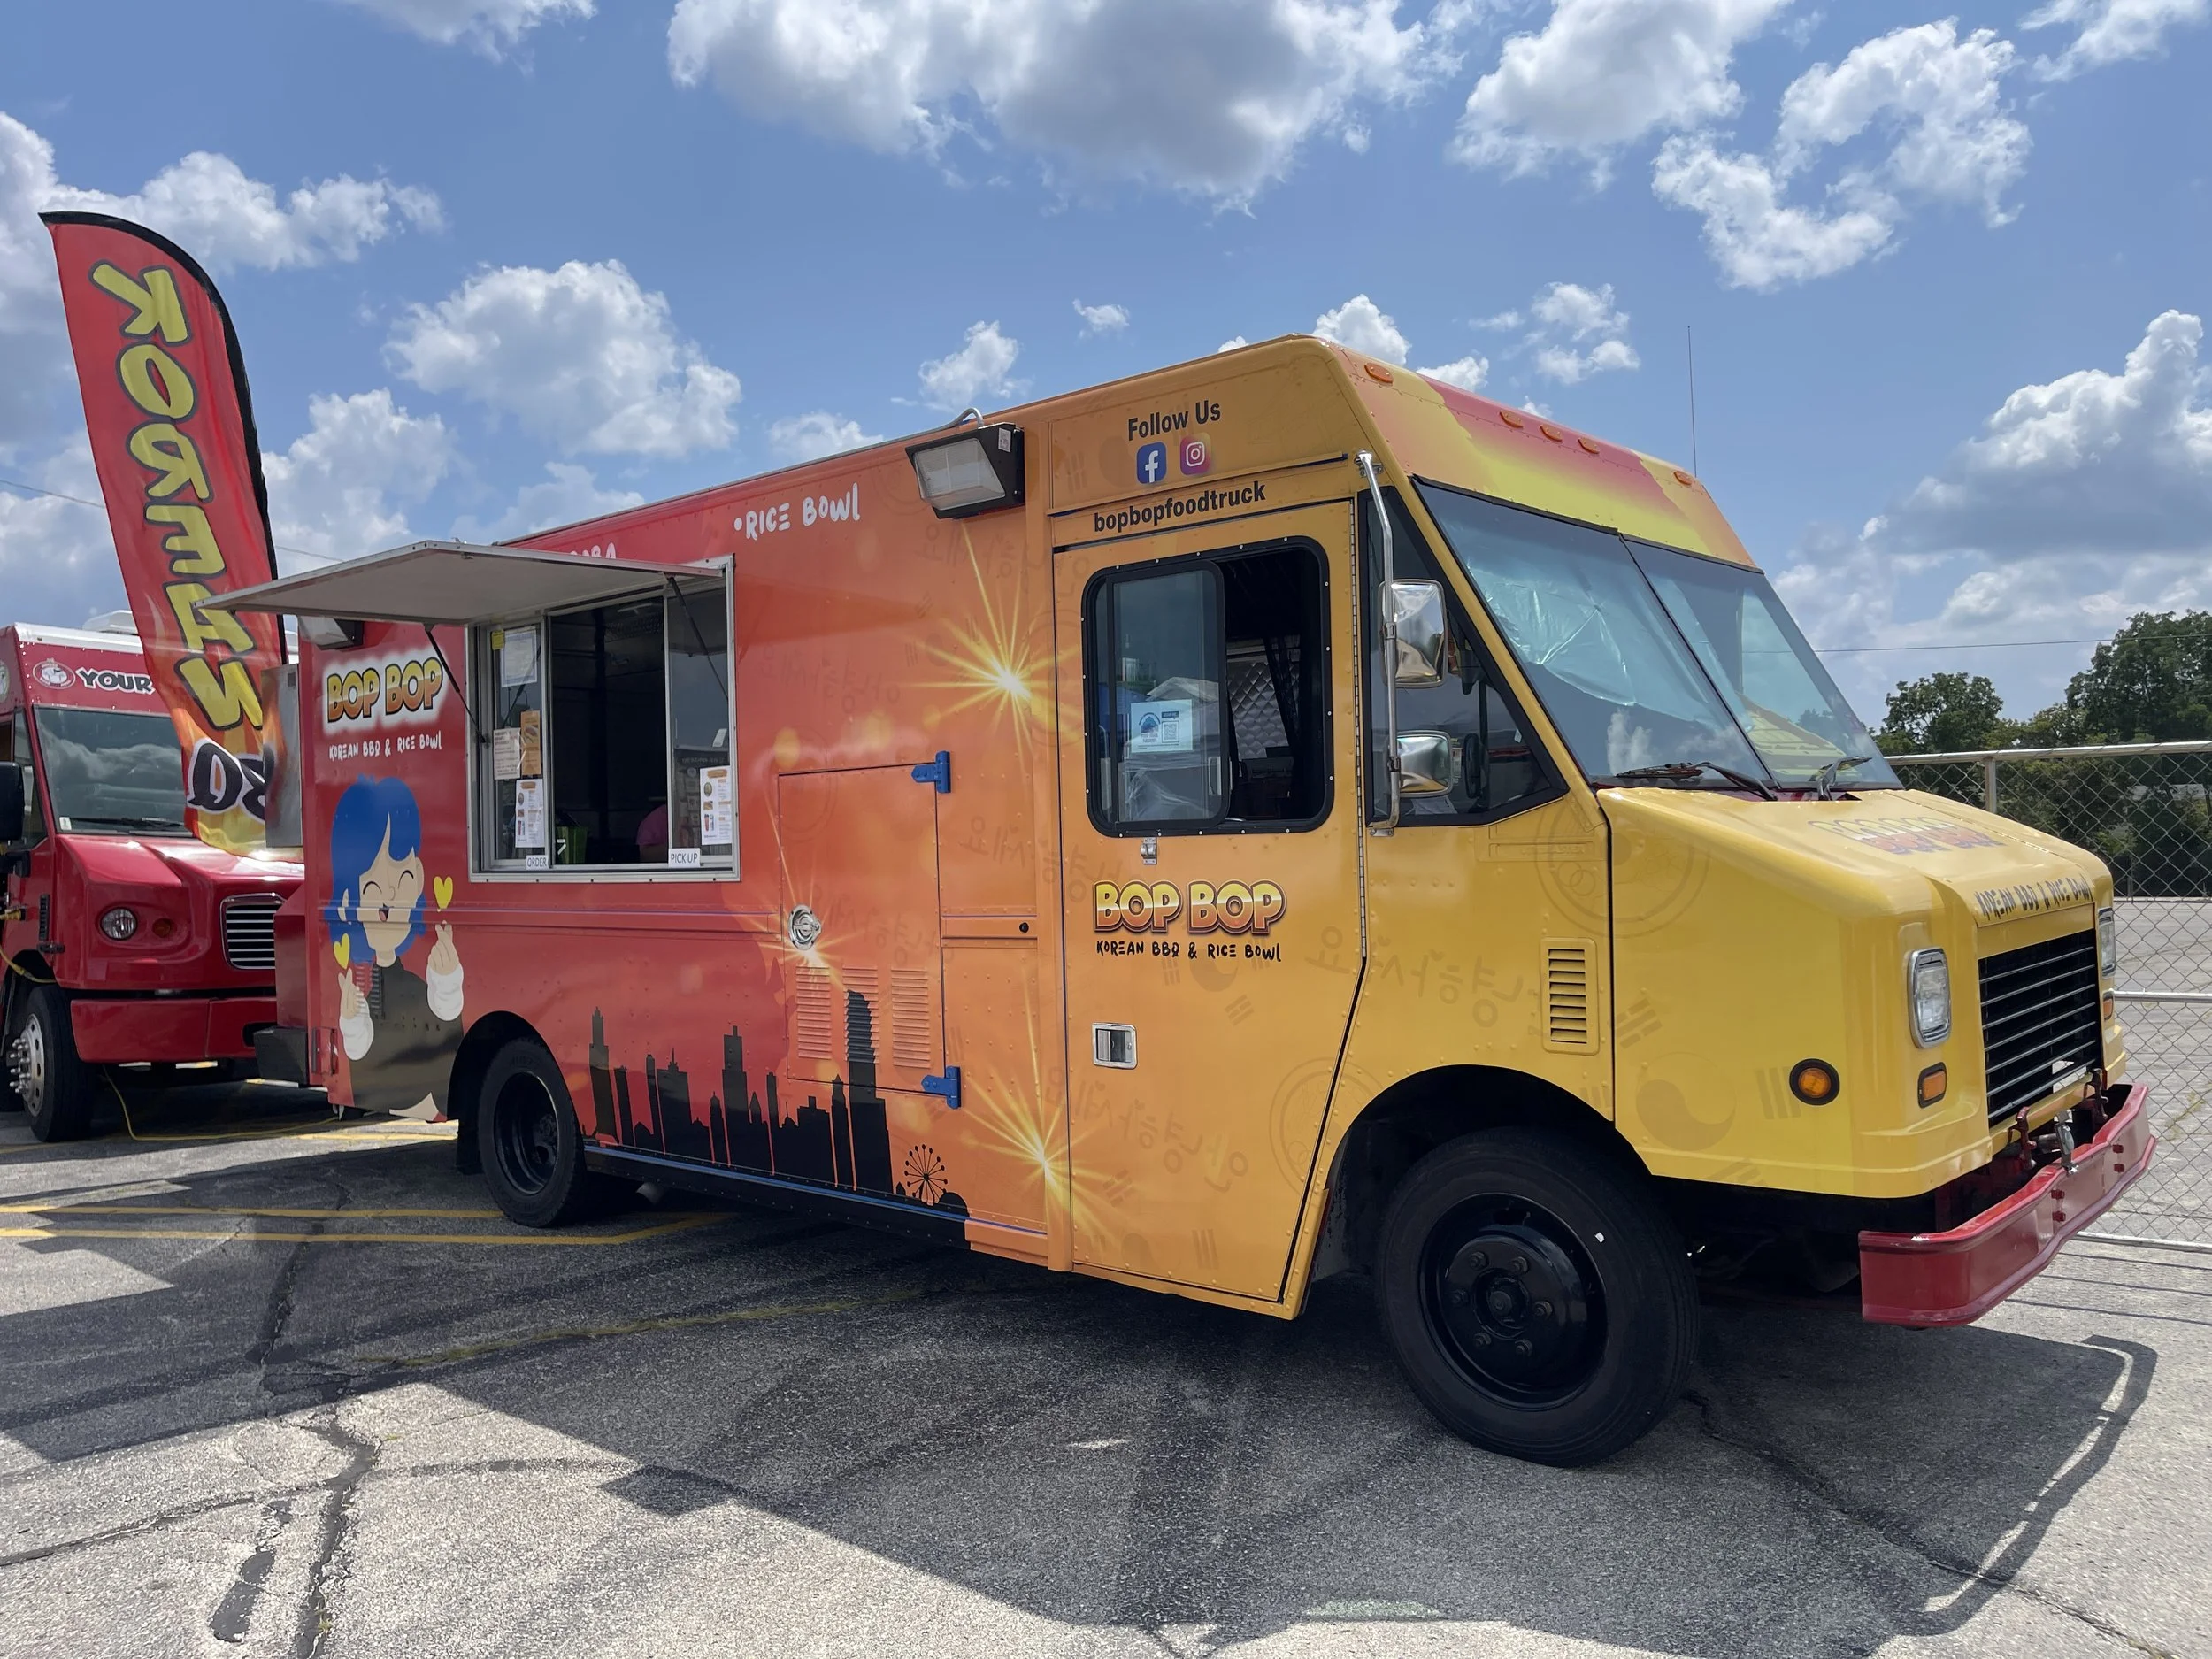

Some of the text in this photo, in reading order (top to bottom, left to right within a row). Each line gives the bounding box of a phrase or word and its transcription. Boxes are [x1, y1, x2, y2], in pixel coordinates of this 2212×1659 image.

[1128, 400, 1221, 442] Follow Us
[744, 502, 791, 541] RICE
[1094, 480, 1266, 533] bopbopfoodtruck
[77, 669, 153, 694] YOUR
[327, 667, 380, 723] BOP
[384, 657, 444, 716] BOP
[329, 730, 442, 762] KOREAN BBQ & RICE BOWL
[526, 856, 547, 868] ORDER
[671, 851, 699, 864] PICK UP
[1094, 879, 1286, 935] BOP BOP
[1974, 888, 2016, 920] KOREAN
[1097, 940, 1282, 963] KOREAN BBQ & RICE BOWL
